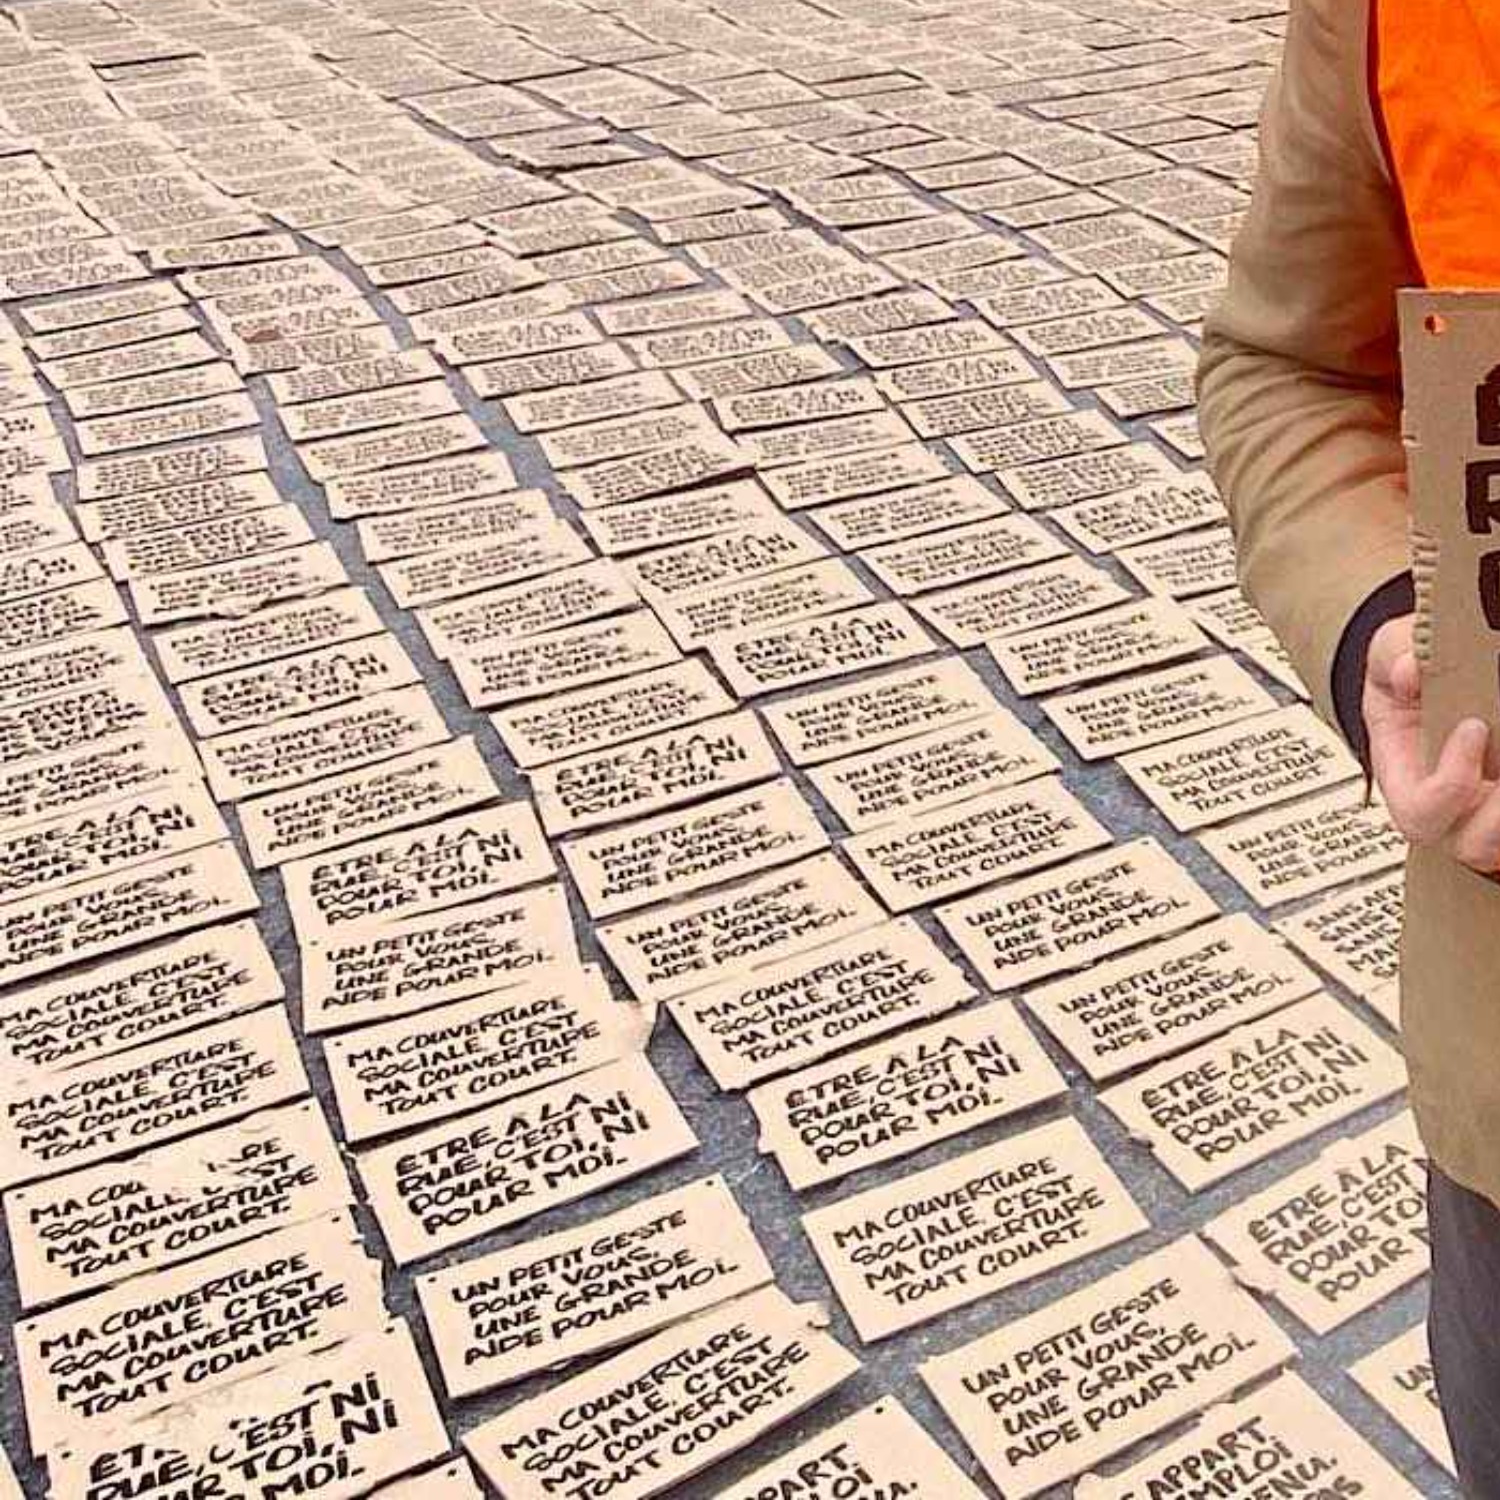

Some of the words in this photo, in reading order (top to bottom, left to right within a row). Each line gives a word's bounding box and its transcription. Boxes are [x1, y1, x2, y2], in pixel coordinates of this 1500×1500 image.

[833, 1220, 884, 1248] MA
[884, 1156, 1056, 1228] COUVERTURE
[864, 1260, 915, 1290] MA
[919, 1187, 1104, 1270] COUVERTURE
[993, 1174, 1072, 1217] C'EST
[40, 1327, 97, 1358] MA
[101, 1253, 308, 1335] COUVERTURE
[224, 1271, 322, 1320] C'EST
[883, 1264, 966, 1305] TOUT
[977, 1219, 1087, 1275] COURT.
[57, 1370, 115, 1401] MA
[123, 1283, 347, 1380] COUVERTURE
[71, 1371, 172, 1417] TOUT
[183, 1317, 318, 1383] COURT.
[961, 1362, 1010, 1394] UN
[1014, 1325, 1086, 1374] PETIT
[1090, 1278, 1180, 1335] GESTE
[1002, 1394, 1068, 1436] UNE
[1077, 1322, 1207, 1401] GRANDE
[987, 1368, 1069, 1413] POUR
[1005, 1419, 1081, 1466] AIDE
[1083, 1371, 1177, 1432] POUR
